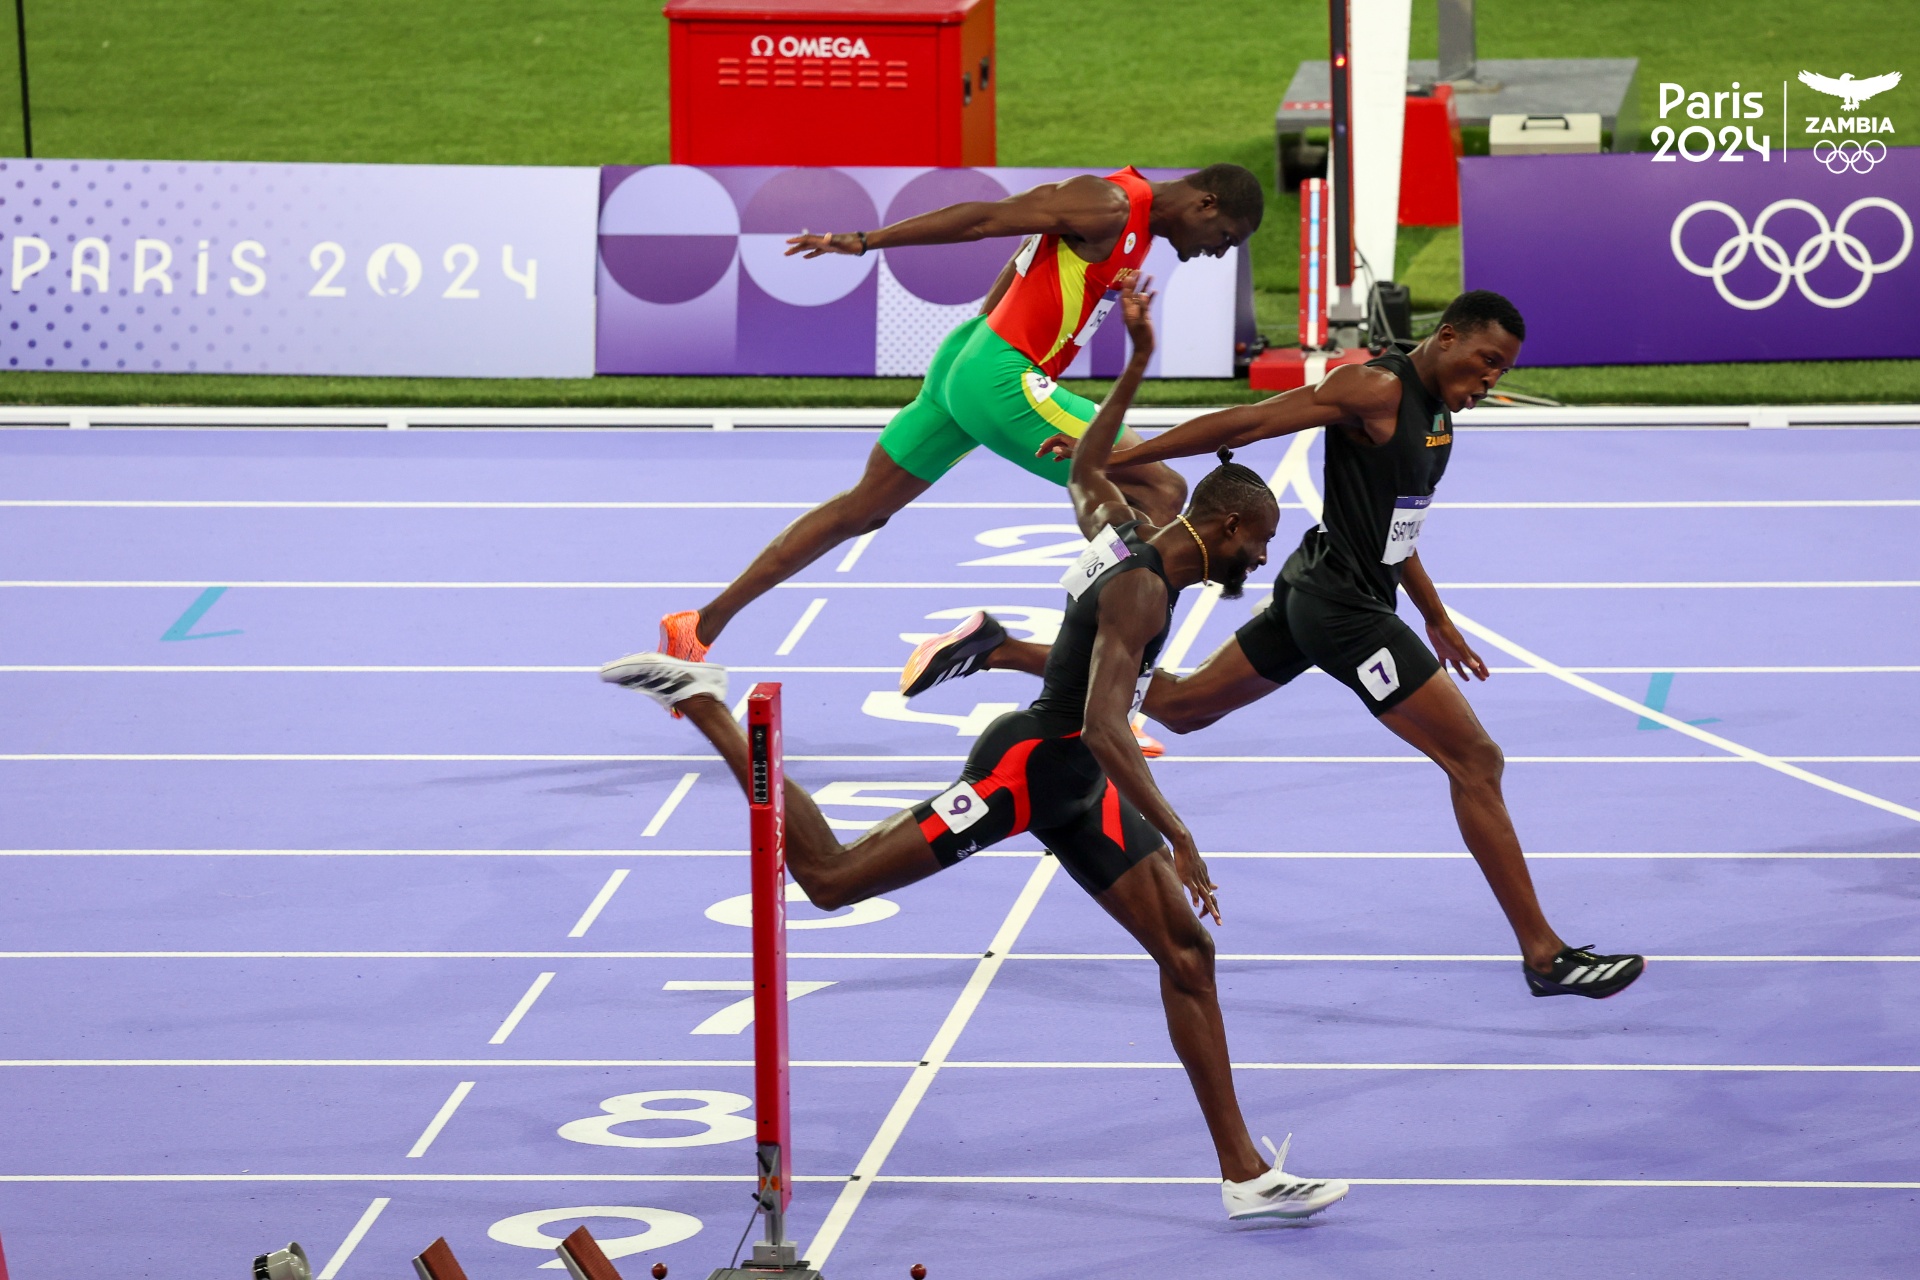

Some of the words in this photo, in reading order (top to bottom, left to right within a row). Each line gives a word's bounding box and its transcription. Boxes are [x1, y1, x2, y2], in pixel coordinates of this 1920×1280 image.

[778, 35, 871, 58] OMEGA
[308, 241, 538, 300] 2024
[957, 524, 1091, 567] 2
[899, 605, 1066, 646] 3
[1368, 660, 1392, 685] 7
[861, 691, 1020, 737] 4
[948, 794, 972, 816] 9
[662, 981, 840, 1035] 7
[557, 1089, 758, 1148] 8
[487, 1205, 704, 1269] 9
